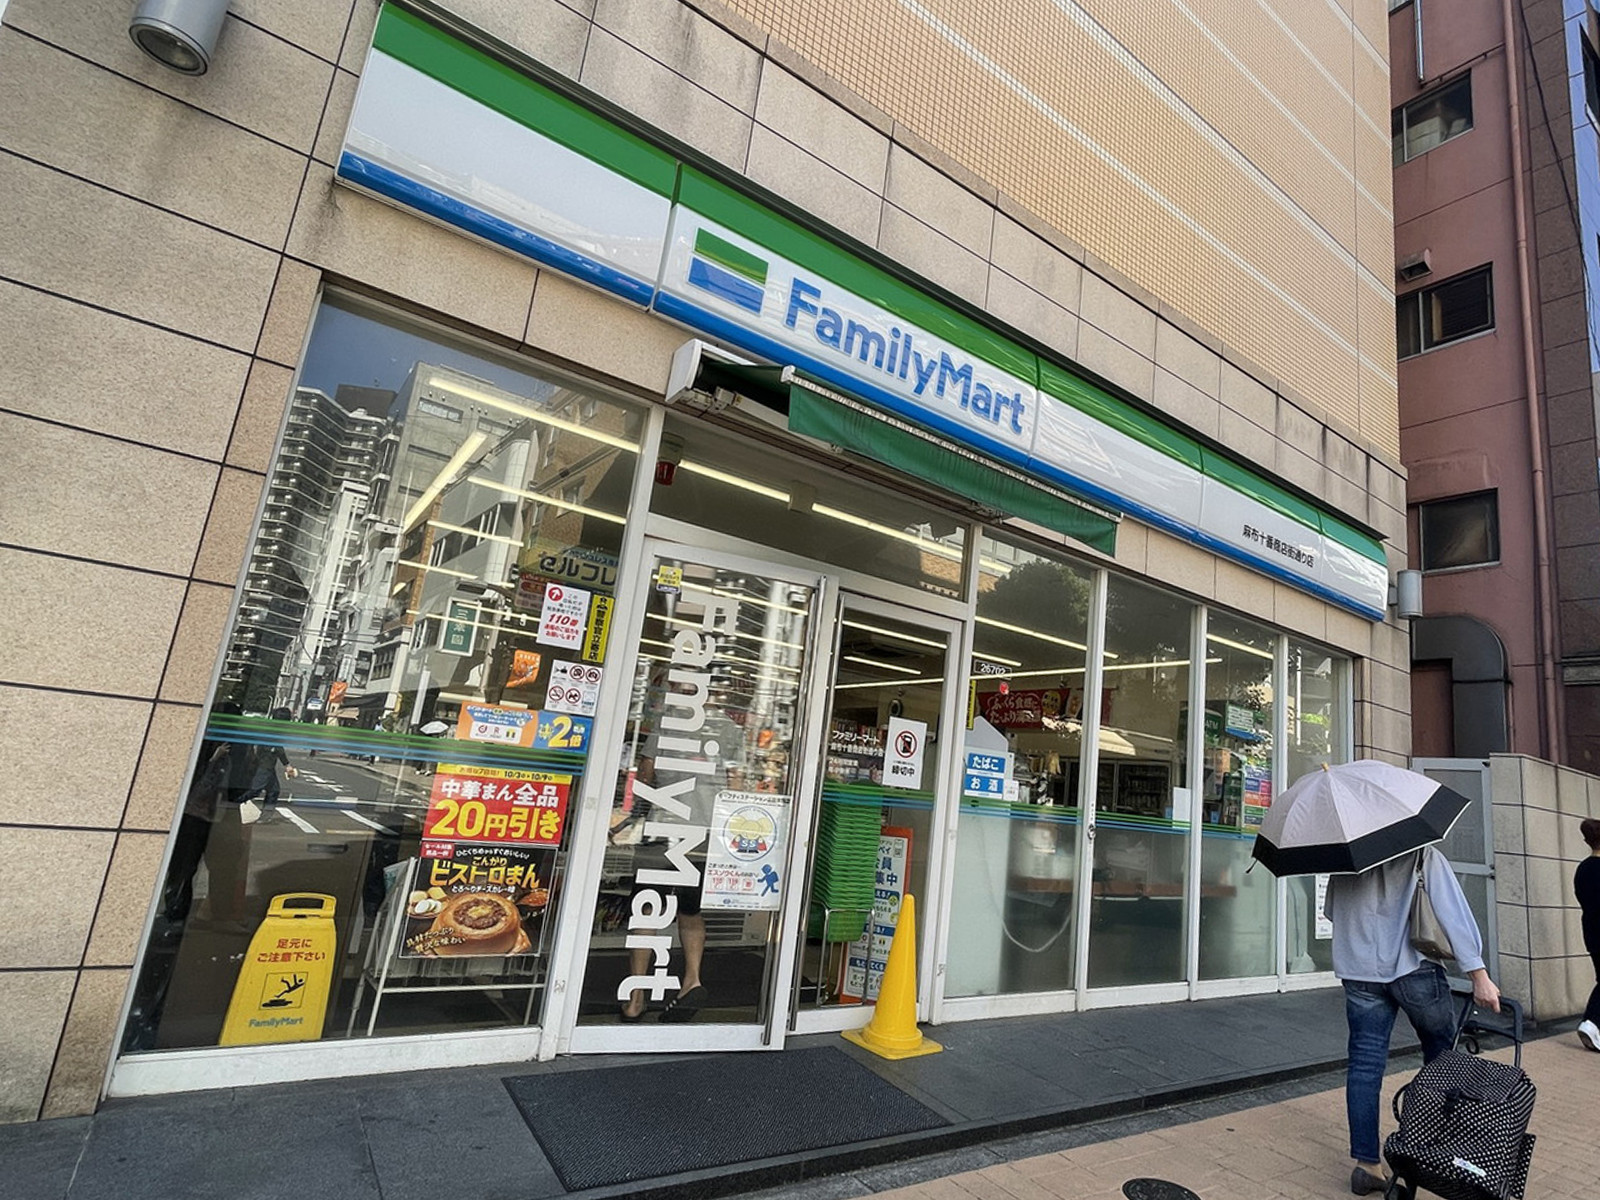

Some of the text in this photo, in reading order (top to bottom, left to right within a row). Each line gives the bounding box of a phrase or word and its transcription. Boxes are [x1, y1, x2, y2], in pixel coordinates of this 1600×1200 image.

[783, 277, 1025, 434] FamilyMart
[1242, 524, 1314, 568] 麻布十番商店街通り店
[548, 613, 579, 627] 110番
[832, 730, 880, 745] ファミリーマート
[972, 755, 999, 770] たばこ
[441, 779, 560, 808] 中華まん全品
[617, 586, 740, 1001] FamilyMart
[430, 799, 562, 840] 20円引き
[472, 856, 508, 867] こんがり
[429, 859, 540, 888] ビストロまん
[276, 938, 314, 949] 足元に
[257, 951, 326, 963] ご注意下さい
[248, 1016, 304, 1028] FamilyMart
